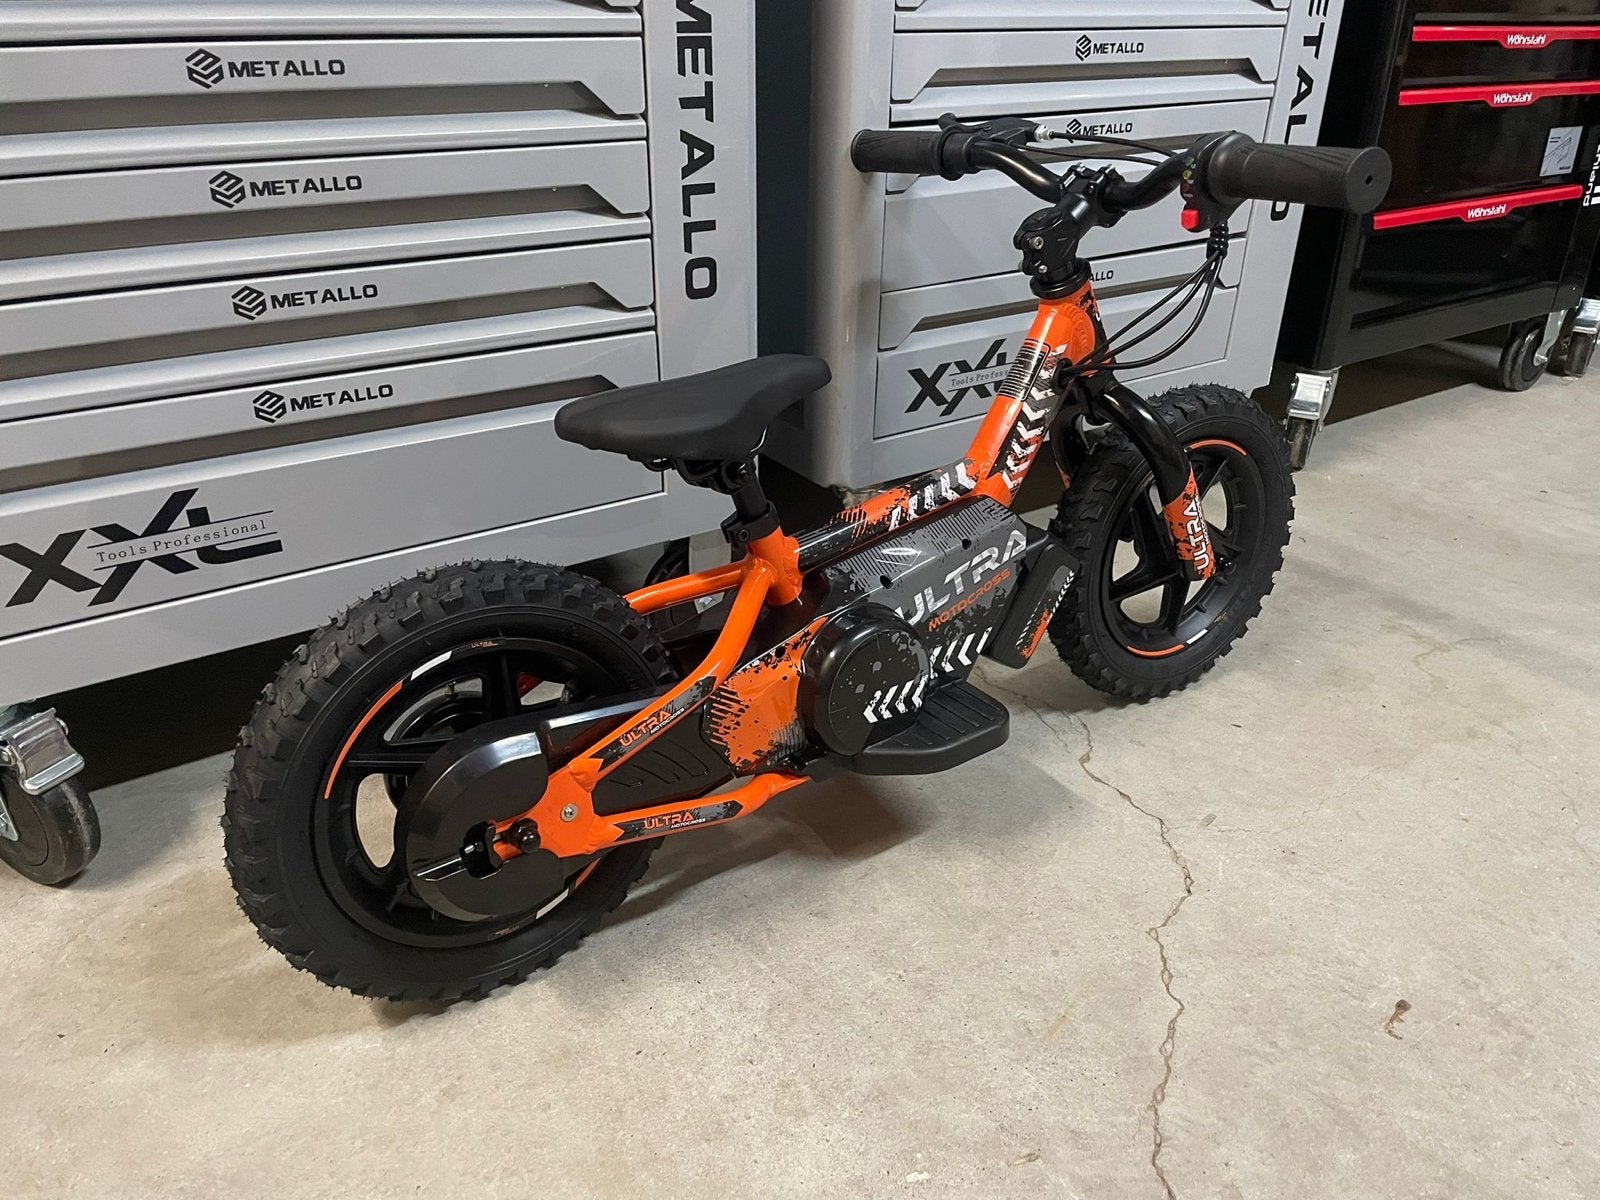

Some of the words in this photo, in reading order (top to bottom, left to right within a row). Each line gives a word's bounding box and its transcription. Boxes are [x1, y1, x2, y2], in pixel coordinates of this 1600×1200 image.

[1092, 42, 1145, 54] METALLO
[1507, 34, 1547, 45] Wöhrstahl
[227, 59, 346, 78] METALLO
[1493, 92, 1533, 104] Wöhrstahl
[1083, 122, 1133, 137] METALLO
[675, 0, 718, 300] METALLO
[249, 175, 363, 197] METALLO
[1467, 204, 1507, 219] Wöhrstahl
[1090, 270, 1114, 281] ALLO
[270, 284, 378, 309] METALLO
[951, 377, 974, 387] Tools
[976, 369, 1009, 382] Profess
[290, 384, 394, 412] METALLO
[96, 545, 147, 563] Tools
[152, 520, 267, 551] Professional
[1183, 499, 1210, 571] ULTRA
[0, 487, 283, 608] XXL
[894, 529, 1027, 626] ULTRA
[928, 567, 1011, 632] MOTOCROSS
[619, 711, 672, 747] ULTRA
[650, 707, 685, 735] MOTOCROSS
[644, 812, 695, 829] ULTRA
[670, 817, 706, 829] MOTOCROSS
